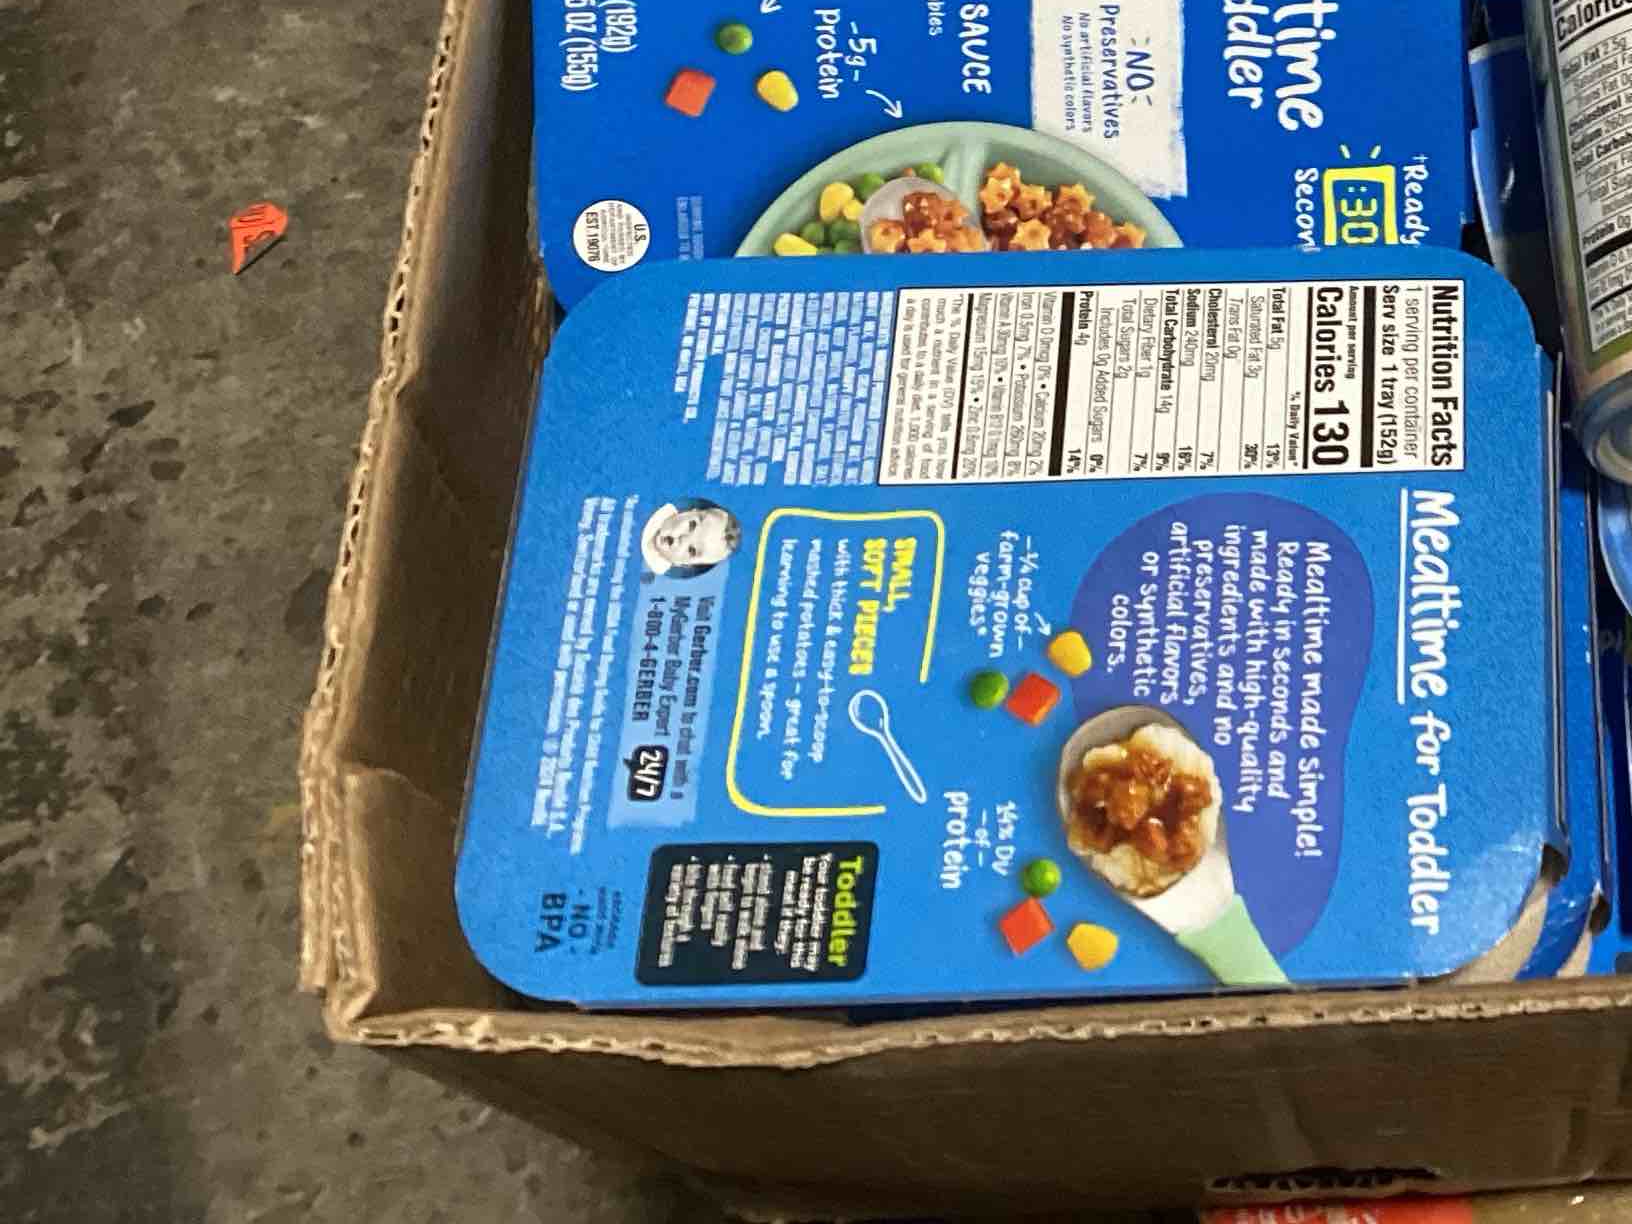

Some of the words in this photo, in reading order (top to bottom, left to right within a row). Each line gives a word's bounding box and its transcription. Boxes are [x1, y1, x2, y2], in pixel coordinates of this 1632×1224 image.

[566, 12, 597, 34] OZ
[600, 0, 637, 53] (192g)
[814, 8, 843, 99] protein
[958, 3, 992, 95] SAUCE
[559, 37, 598, 91] (155g)
[1079, 33, 1093, 87] artificial
[1099, 4, 1120, 140] Preservatives
[1186, 288, 1201, 328] Sodium
[1206, 288, 1222, 354] Cholesterol
[1314, 286, 1344, 394] Calories
[1383, 285, 1400, 323] Serv
[1404, 298, 1420, 353] serving
[1431, 285, 1459, 390] Nutrition
[1158, 319, 1179, 392] Carbohydrate
[1382, 328, 1399, 359] size
[1377, 378, 1398, 410] tray
[1404, 386, 1421, 459] container
[1311, 400, 1350, 466] 130
[1376, 414, 1399, 465] (152g)
[1431, 396, 1459, 467] Facts
[988, 530, 1020, 659] farm-grown
[1140, 550, 1160, 577] or
[1165, 521, 1192, 617] artificial
[1217, 524, 1247, 657] ingredients
[1249, 529, 1272, 594] made
[1270, 541, 1300, 613] Ready
[1407, 488, 1459, 700] Mealtime
[1107, 592, 1133, 674] colors.
[1183, 539, 1215, 706] preservatives,
[1245, 598, 1270, 654] with
[1273, 620, 1298, 641] in
[1303, 541, 1332, 665] Mealtime
[1133, 582, 1160, 698] synthetic
[1160, 622, 1188, 706] flavors
[1215, 663, 1238, 711] and
[1268, 647, 1293, 745] seconds
[1299, 673, 1328, 749] made
[1213, 715, 1232, 746] no
[1232, 659, 1267, 813] high-quality
[1407, 713, 1459, 778] for
[633, 749, 663, 797] 24/7
[1267, 750, 1291, 800] and
[1290, 757, 1325, 858] simple!
[939, 790, 970, 889] protein
[1405, 784, 1456, 937] Toddler
[535, 892, 564, 953] BPA
[828, 855, 863, 967] Toddler
